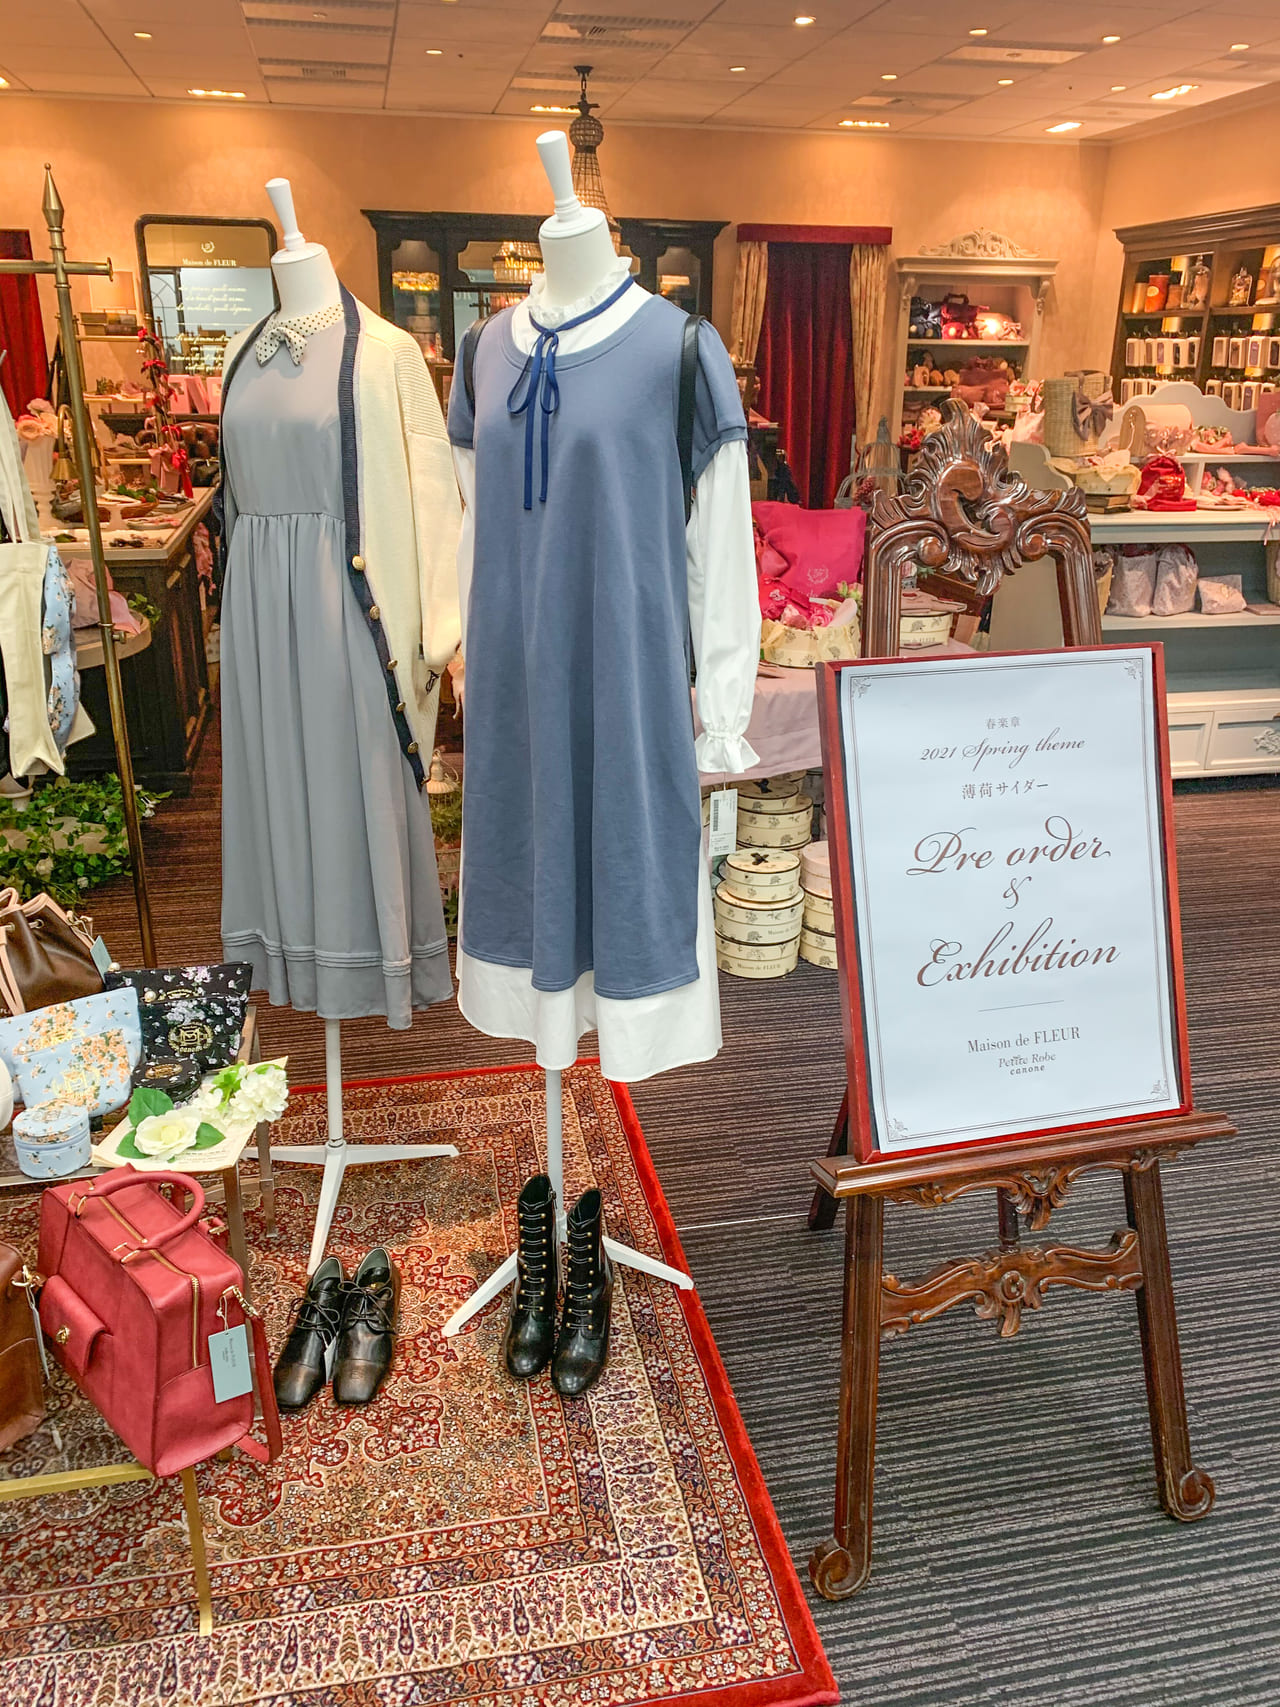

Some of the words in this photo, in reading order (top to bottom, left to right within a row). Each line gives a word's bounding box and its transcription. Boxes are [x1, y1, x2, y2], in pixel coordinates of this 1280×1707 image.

[504, 257, 540, 269] Maison
[986, 716, 1021, 730] 春楽章
[919, 746, 958, 761] 2021
[961, 737, 1030, 772] Spring
[1034, 726, 1087, 752] theme
[961, 778, 1049, 800] 薄荷サイダー
[906, 826, 996, 876] Pre
[1005, 815, 1112, 867] order
[1002, 875, 1033, 910] &
[916, 916, 1121, 988] Exhibition
[968, 1038, 1011, 1054] Maison
[1015, 1033, 1030, 1047] de
[1034, 1026, 1081, 1045] FLEUR
[998, 1054, 1029, 1068] Petite
[1031, 1051, 1057, 1064] Robe
[1009, 1065, 1046, 1076] canone
